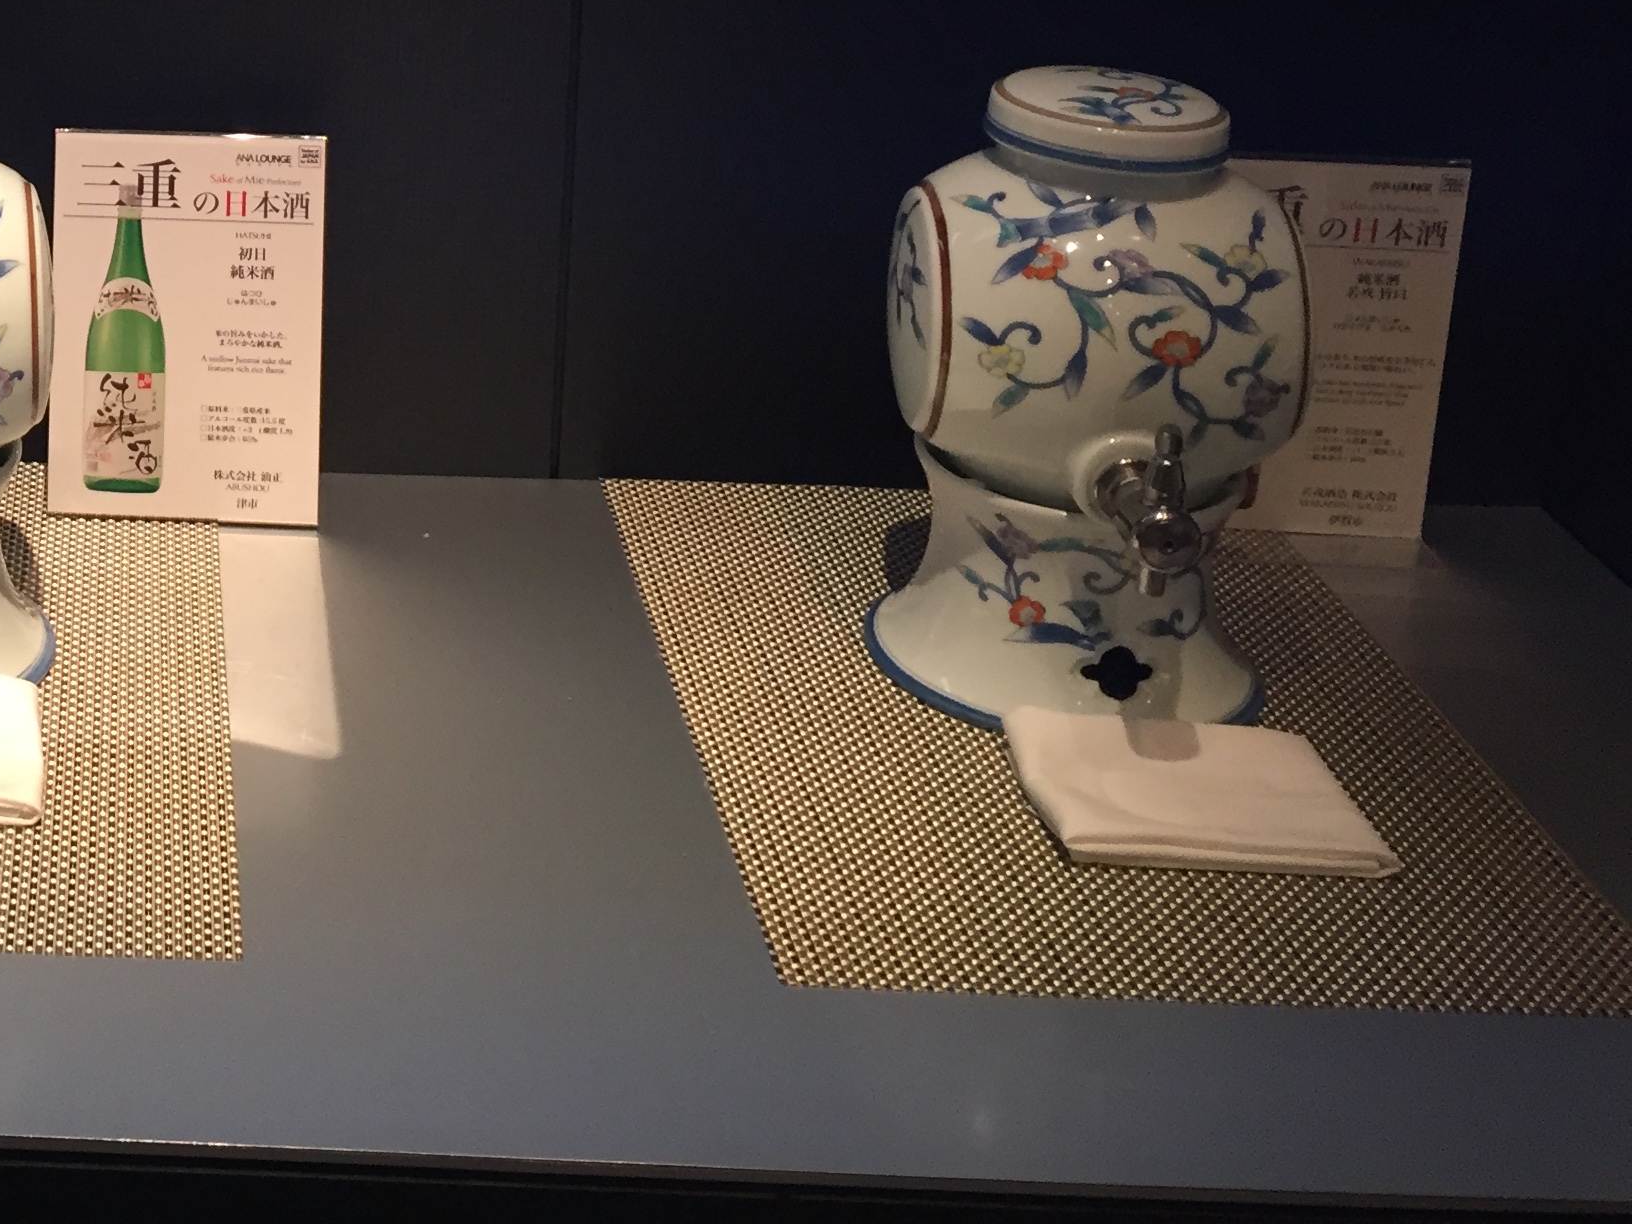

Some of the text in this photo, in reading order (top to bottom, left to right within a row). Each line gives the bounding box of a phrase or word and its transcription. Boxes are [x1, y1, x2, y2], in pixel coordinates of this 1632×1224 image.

[236, 153, 292, 164] ANA LOUNGE
[210, 173, 234, 185] Sake
[238, 245, 267, 262] 初日
[229, 264, 275, 281] 純米酒
